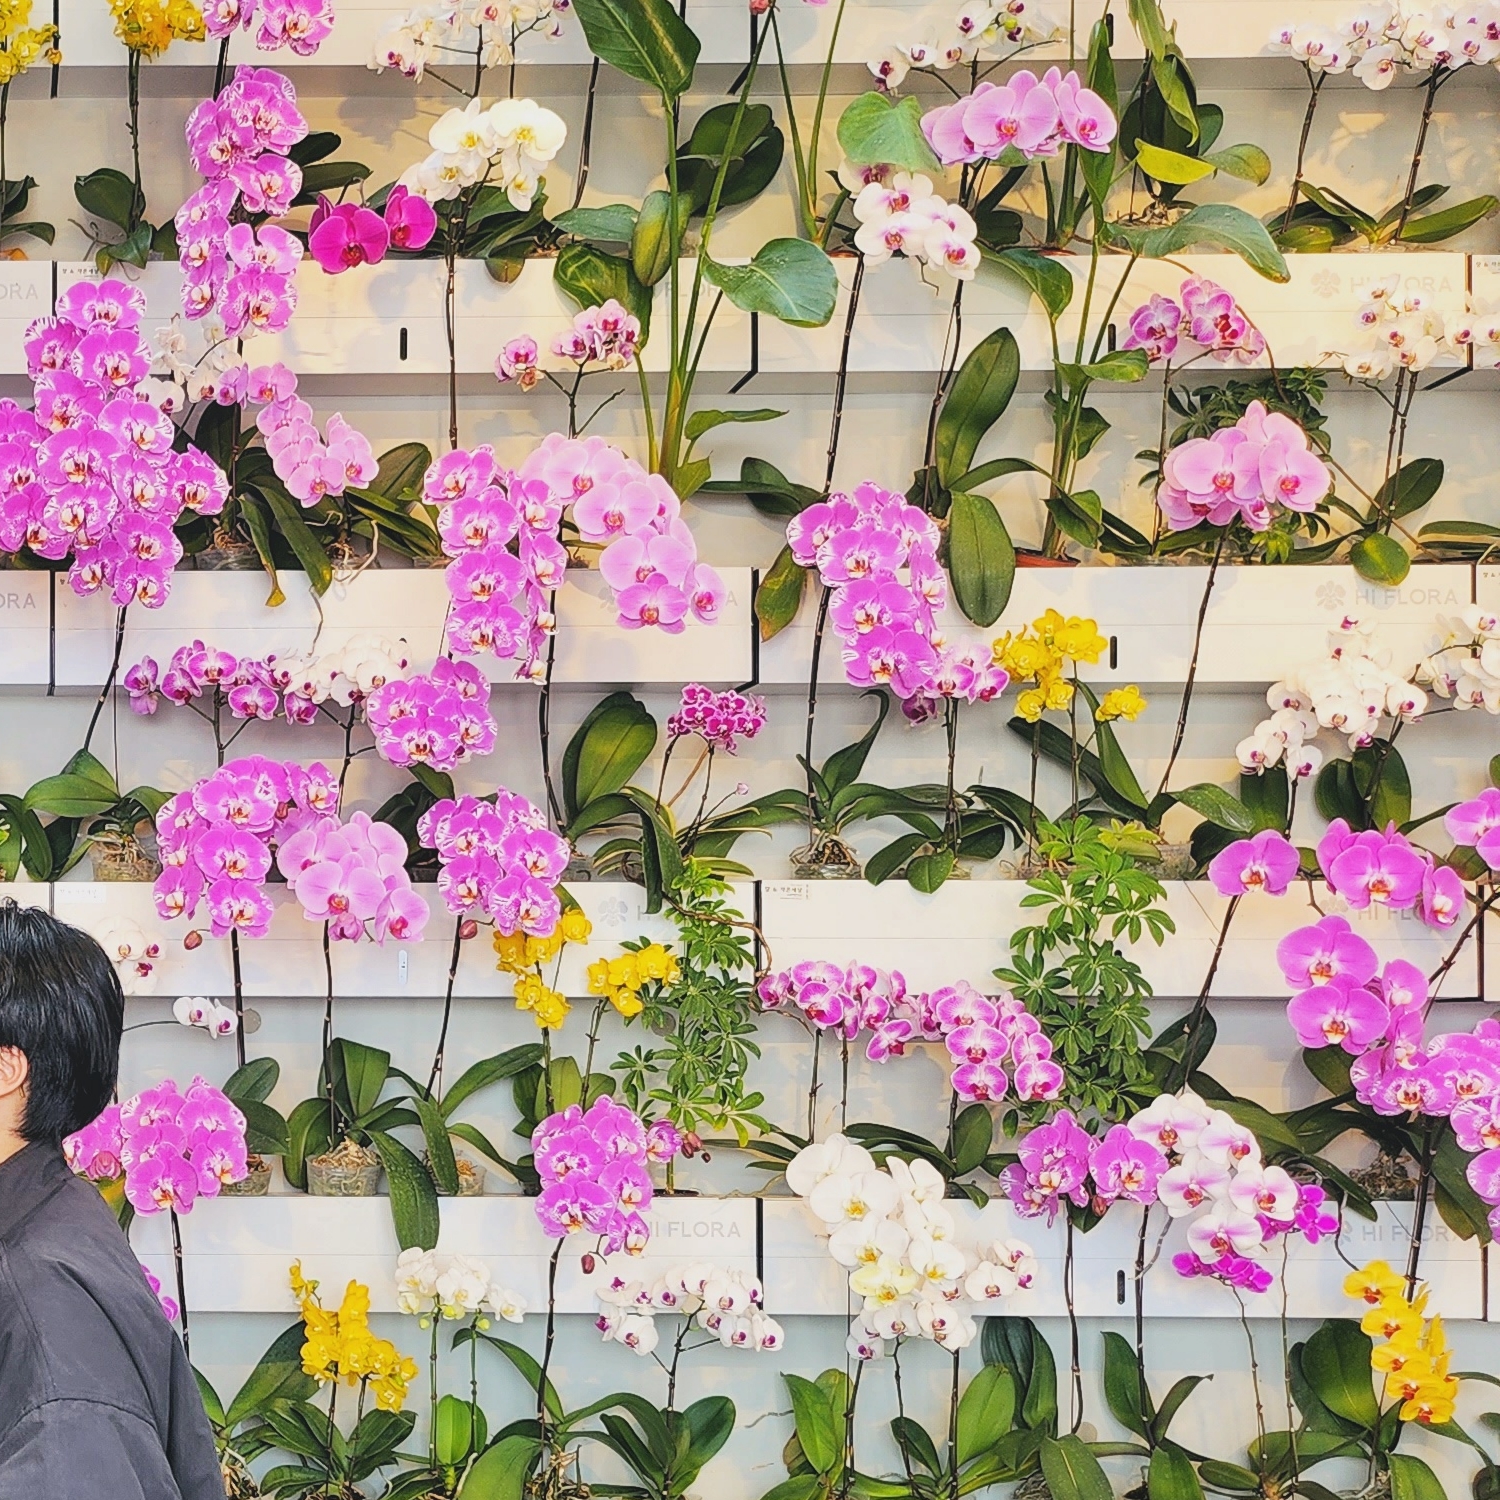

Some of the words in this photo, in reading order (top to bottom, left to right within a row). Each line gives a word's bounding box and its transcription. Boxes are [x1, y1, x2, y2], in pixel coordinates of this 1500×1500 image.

[1355, 589, 1376, 605] HI
[1384, 589, 1457, 606] FLORA
[668, 1221, 741, 1238] FLORA
[1362, 1225, 1382, 1241] HI
